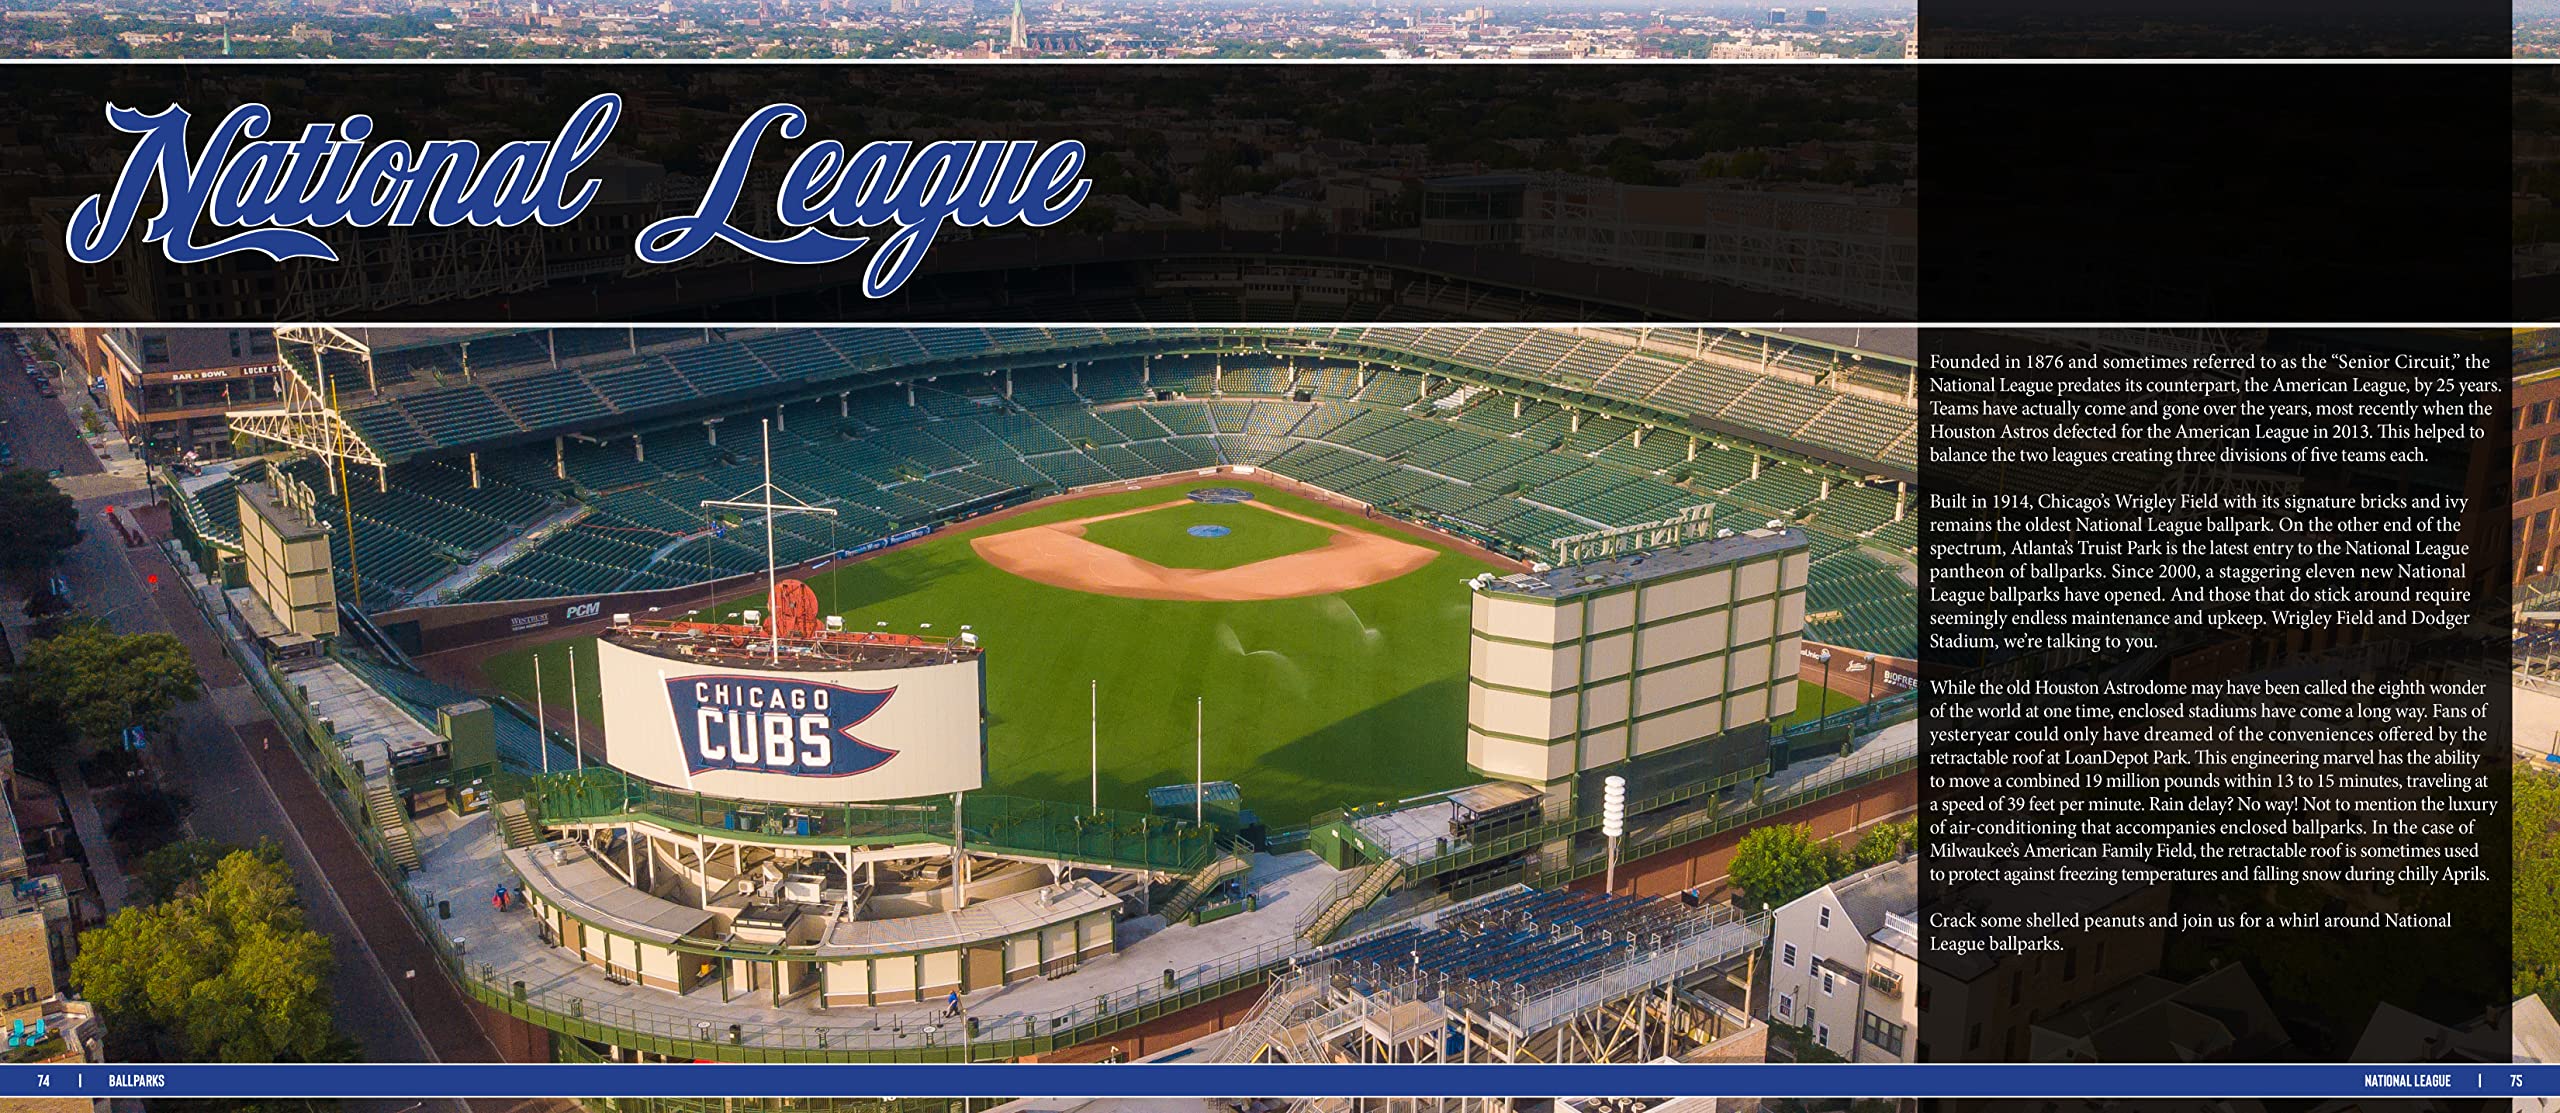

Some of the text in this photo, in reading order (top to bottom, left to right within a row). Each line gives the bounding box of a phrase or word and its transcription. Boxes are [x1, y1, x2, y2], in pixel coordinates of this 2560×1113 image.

[172, 370, 227, 381] BAR BOWL
[243, 366, 268, 375] LUCKY
[566, 601, 601, 619] PCM
[1884, 670, 1918, 688] BIOFREE
[695, 681, 829, 710] CHICAGO
[697, 706, 833, 768] CUBS
